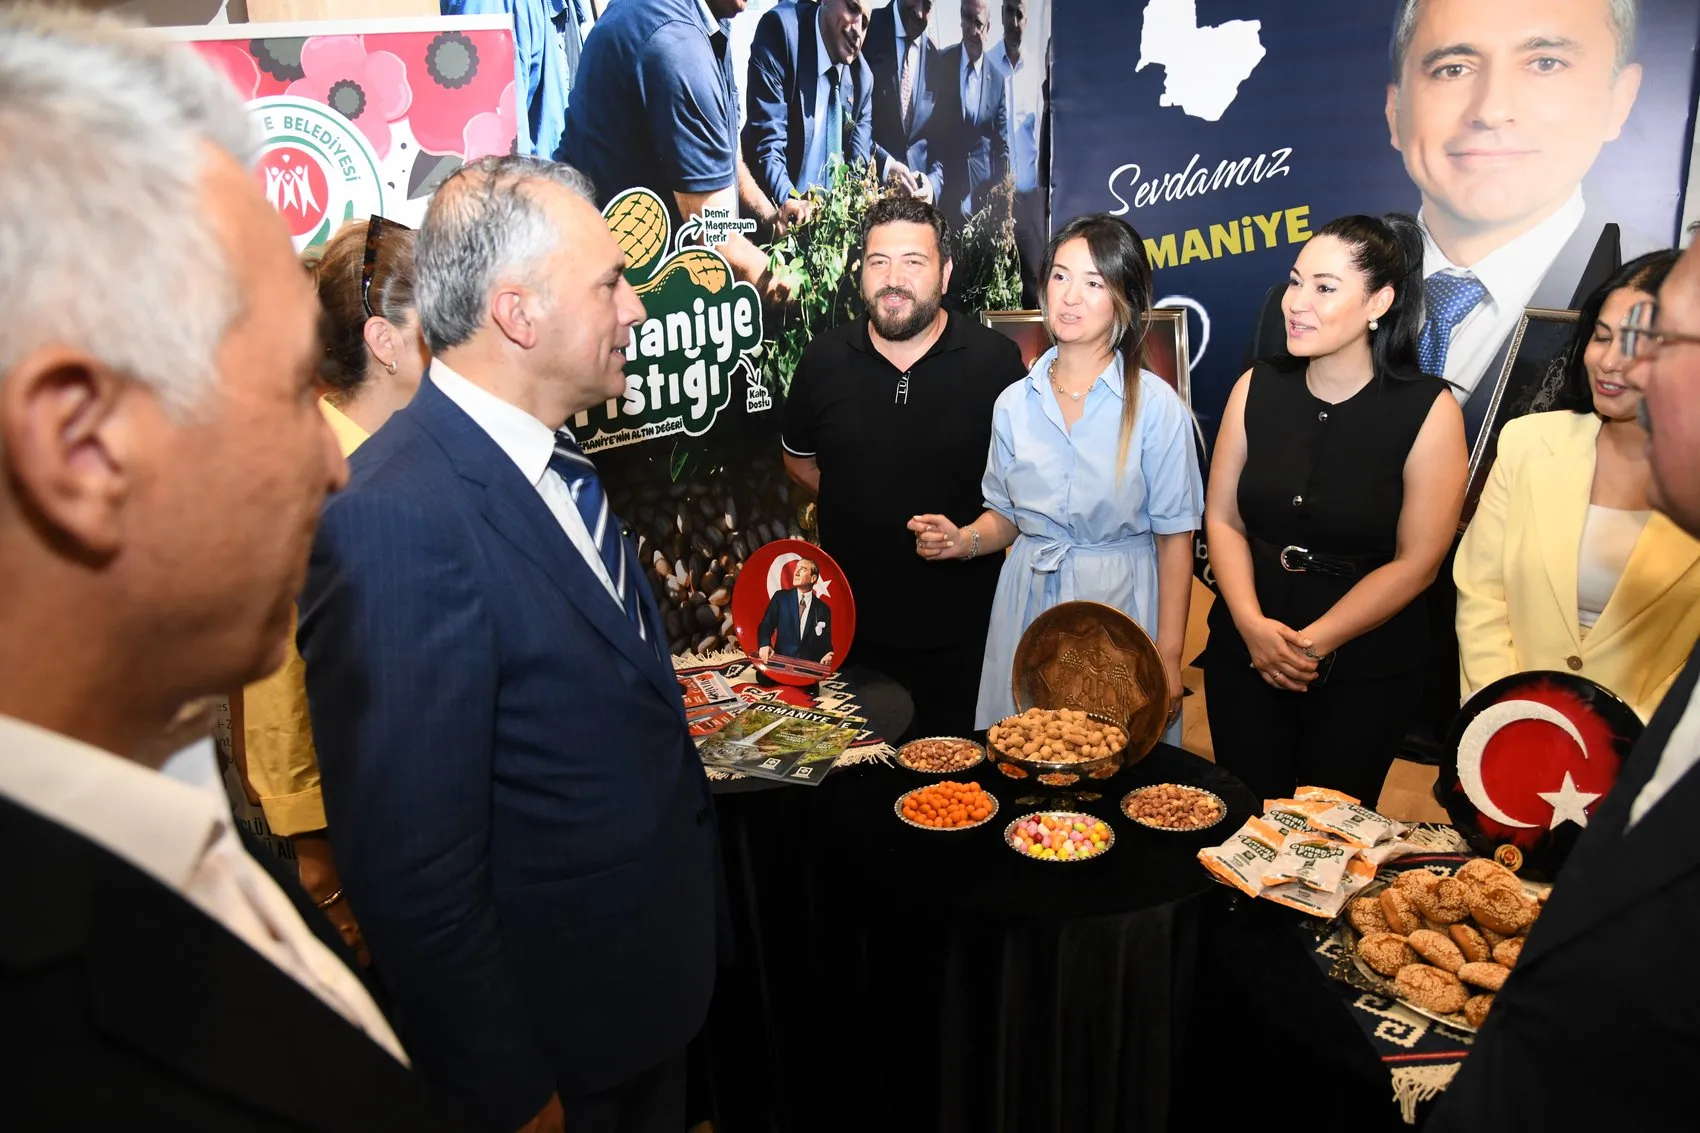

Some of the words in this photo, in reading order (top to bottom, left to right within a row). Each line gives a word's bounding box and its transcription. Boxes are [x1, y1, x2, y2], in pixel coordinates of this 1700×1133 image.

[704, 208, 730, 218] Demir
[705, 220, 755, 235] Magnezyum
[749, 388, 767, 401] Kalp
[748, 399, 770, 410] Dostu
[631, 427, 654, 439] ALTIN
[656, 418, 683, 435] DEĞERİ
